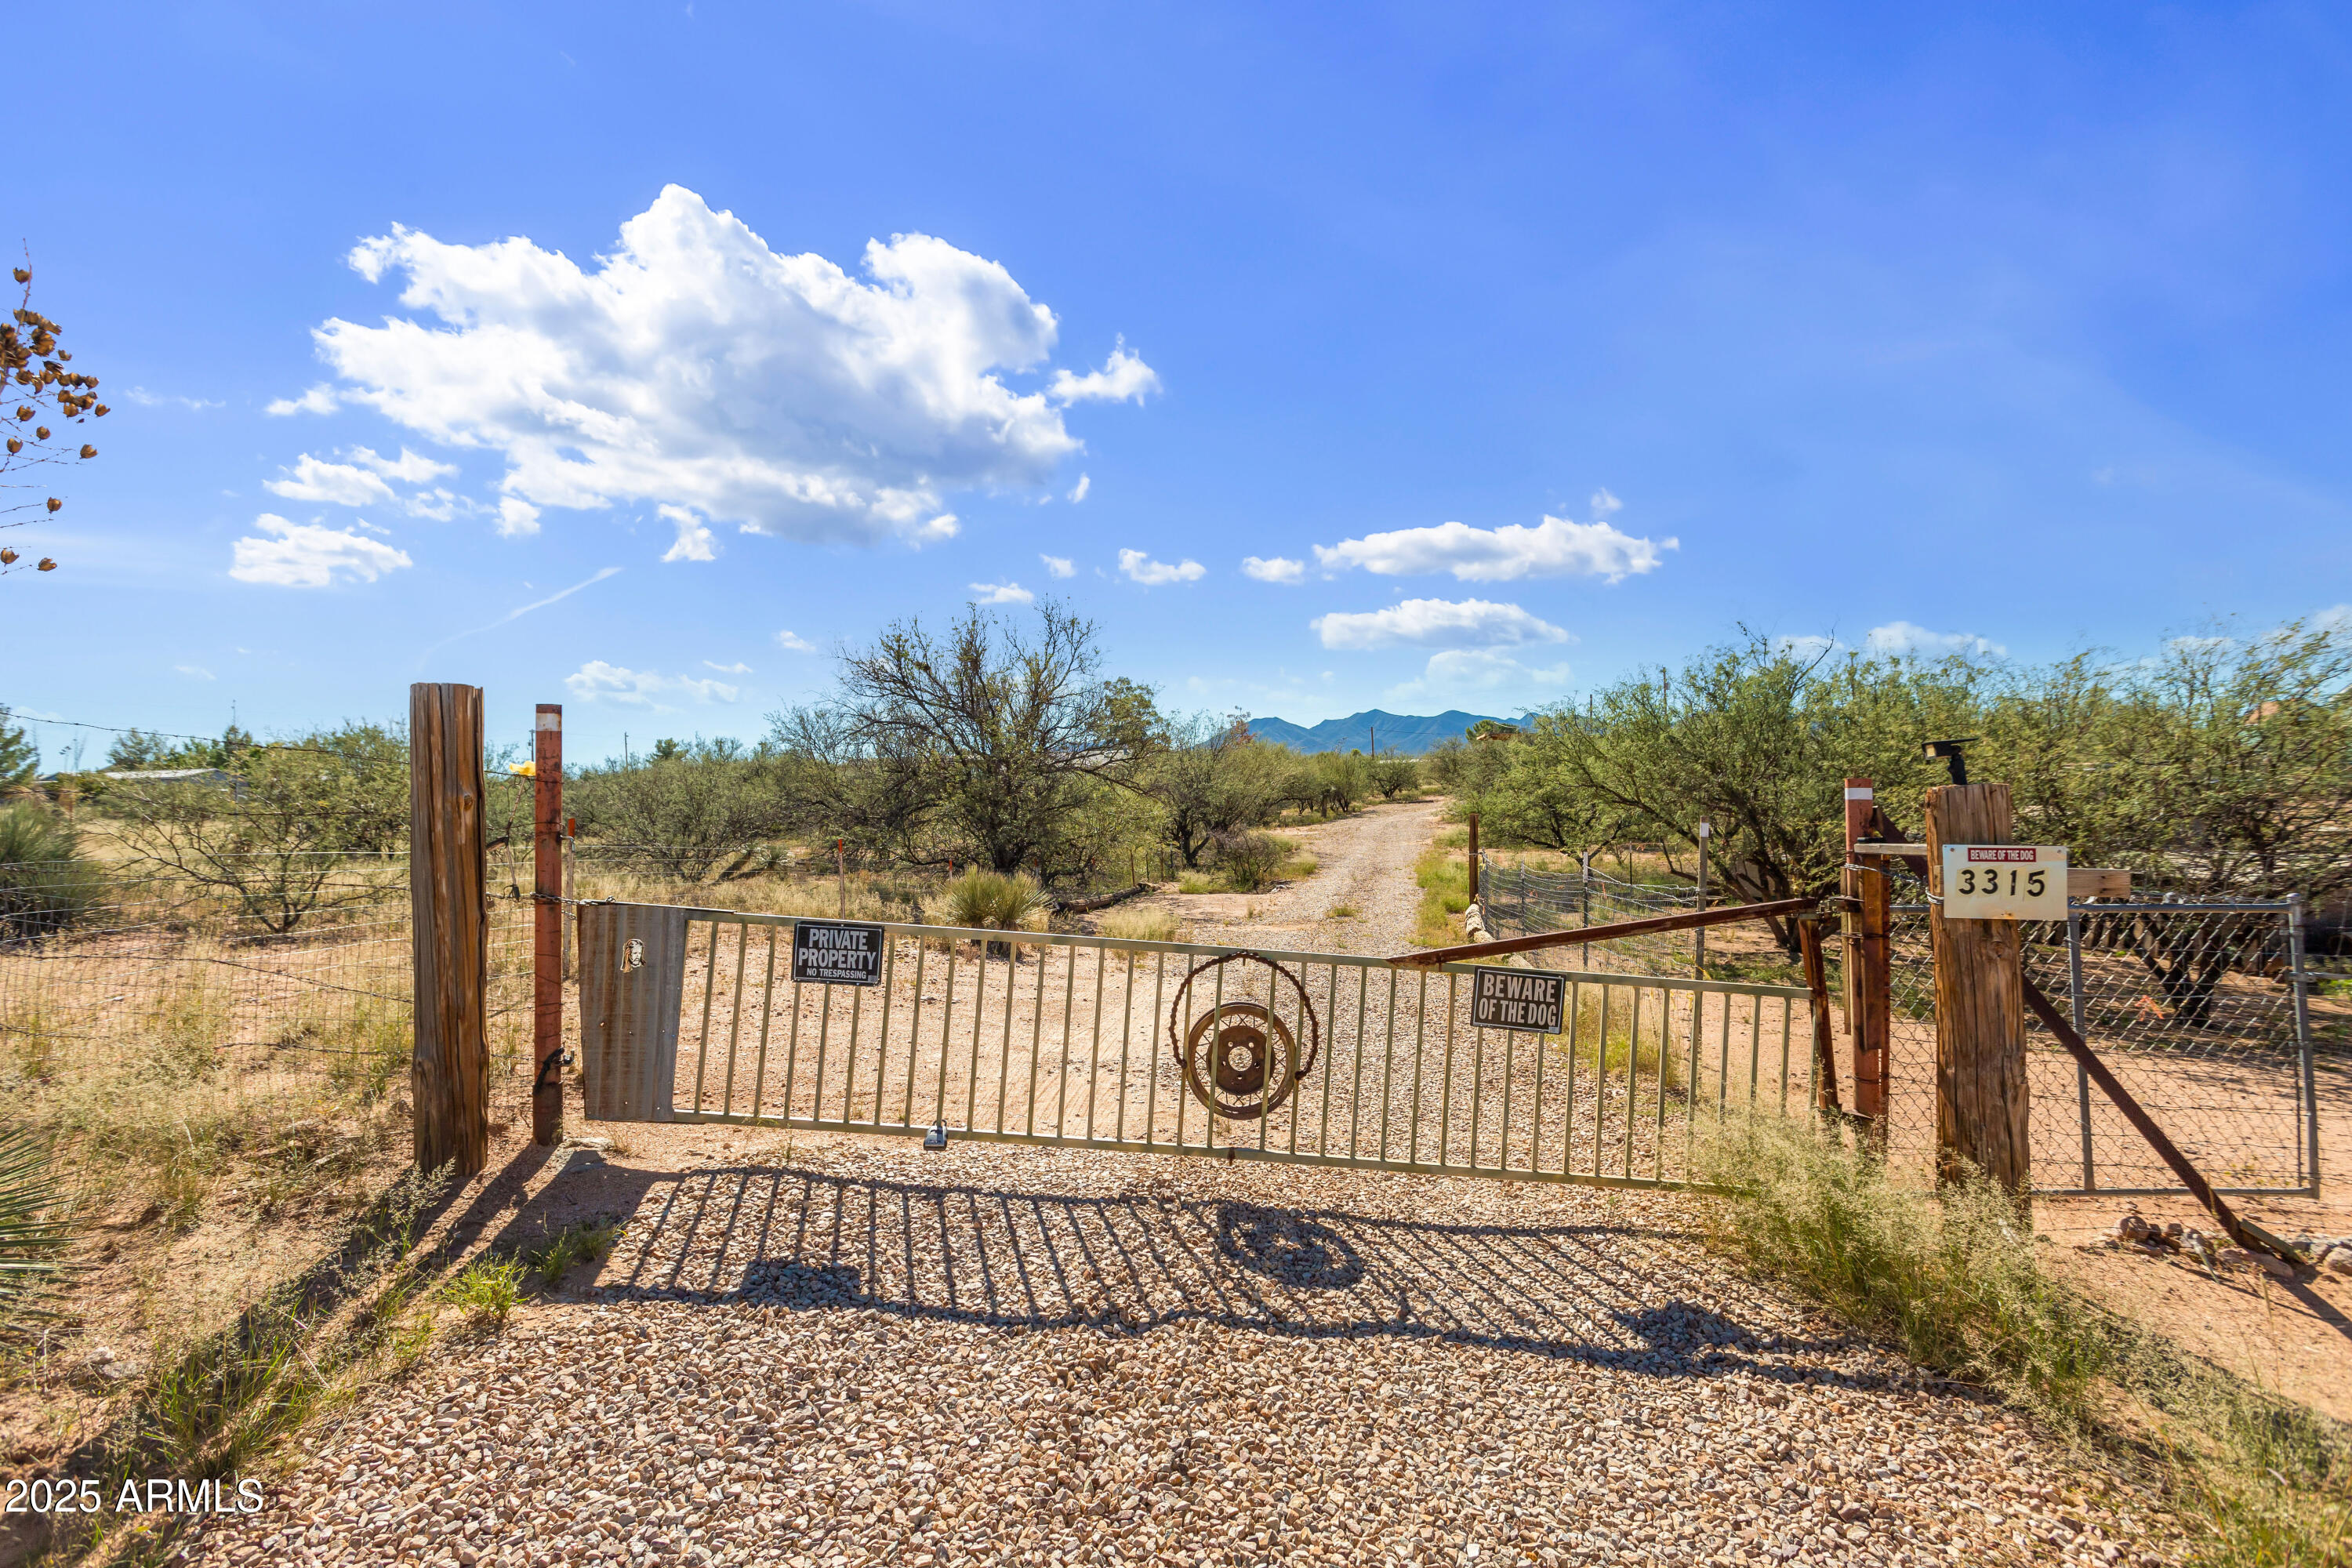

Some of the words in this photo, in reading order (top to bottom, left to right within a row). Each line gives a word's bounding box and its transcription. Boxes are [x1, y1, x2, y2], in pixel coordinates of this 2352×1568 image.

[1970, 850, 1997, 860] BEWARE
[1997, 850, 2006, 860] OF
[2007, 850, 2020, 860] THE
[2020, 850, 2034, 860] DOG
[1958, 869, 2045, 897] 3315
[808, 928, 869, 950] PRIVATE
[798, 947, 877, 970] PROPERTY
[807, 967, 817, 976] NO
[819, 968, 866, 979] TRESPASSING
[1483, 974, 1556, 1003] BEWARE
[1479, 997, 1497, 1020] OF
[1500, 1000, 1526, 1023] THE
[1527, 1003, 1556, 1026] DOG
